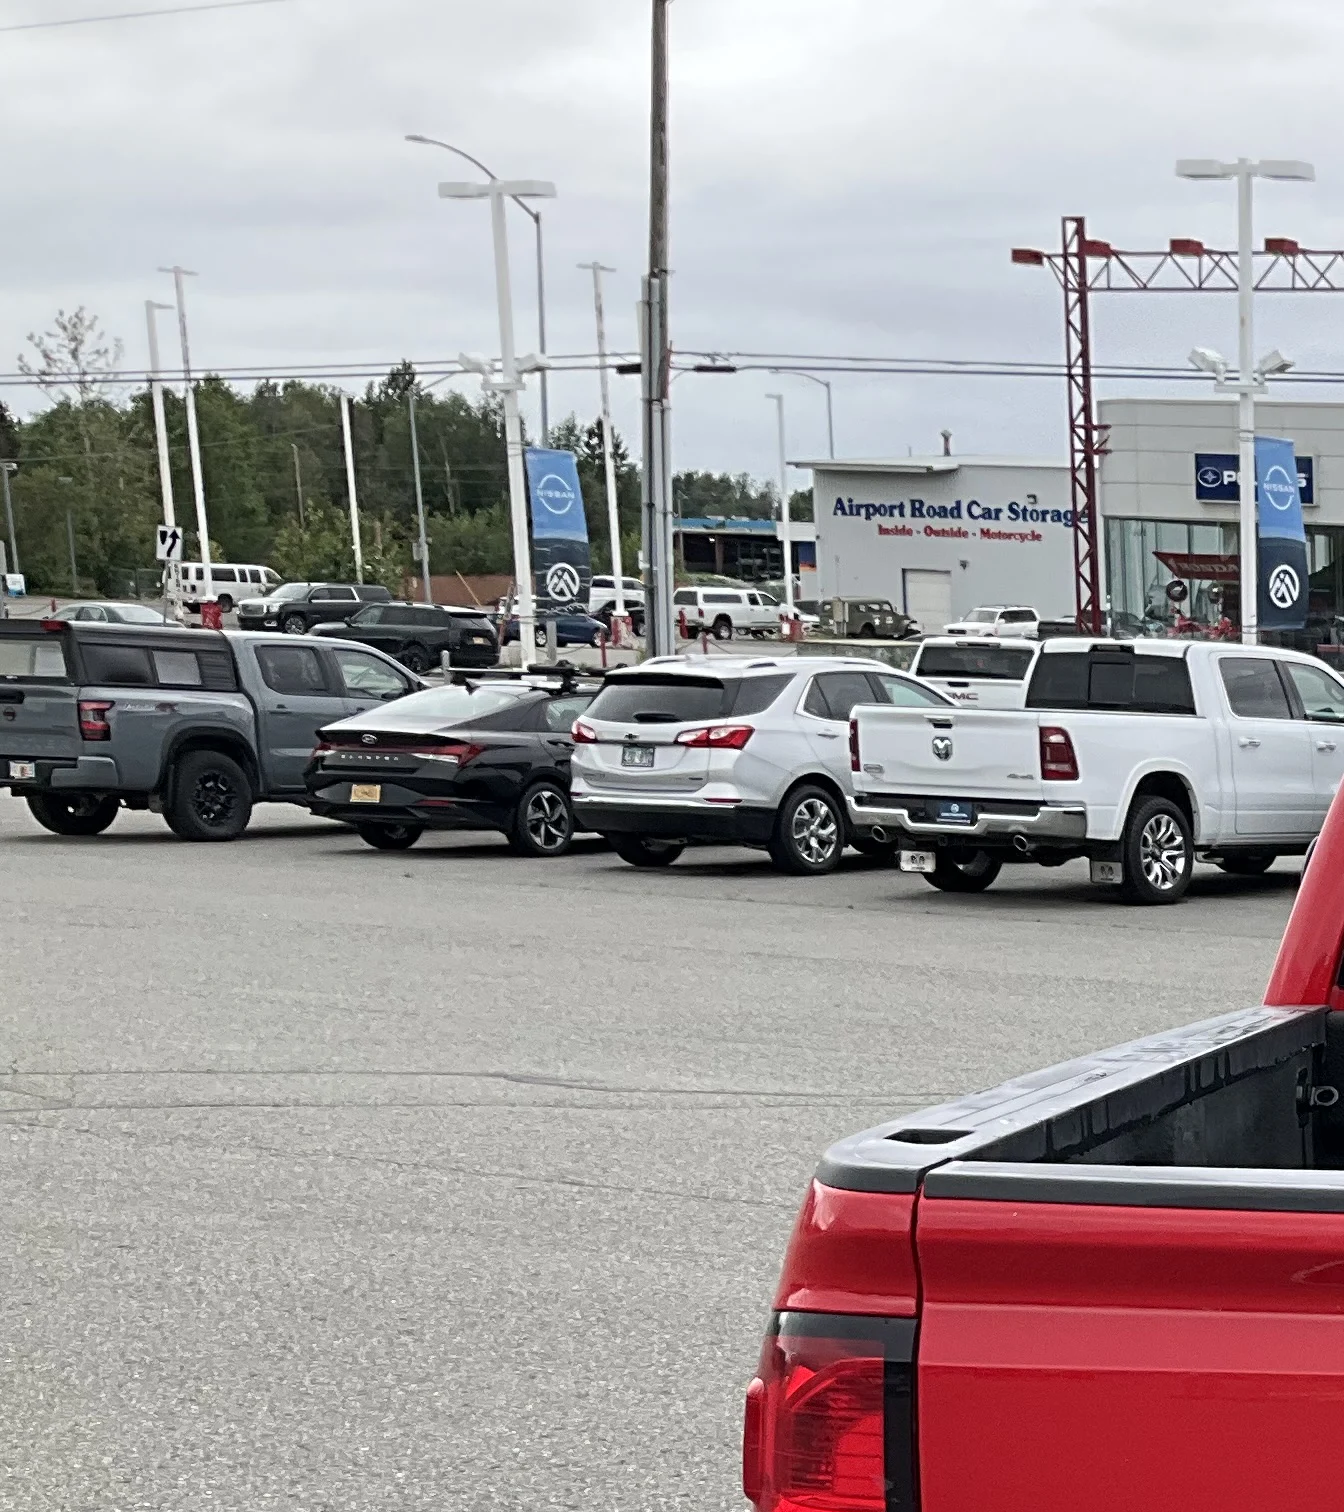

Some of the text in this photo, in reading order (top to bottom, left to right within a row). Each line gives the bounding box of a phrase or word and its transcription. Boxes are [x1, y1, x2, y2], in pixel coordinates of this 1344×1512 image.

[536, 488, 575, 499] NISSAN
[1263, 483, 1295, 493] NISSAN
[833, 496, 905, 521] Airport
[910, 498, 962, 519] Road
[966, 500, 1003, 521] Car
[877, 524, 1043, 543] Inside Outside Motorcycle
[946, 692, 979, 701] MC
